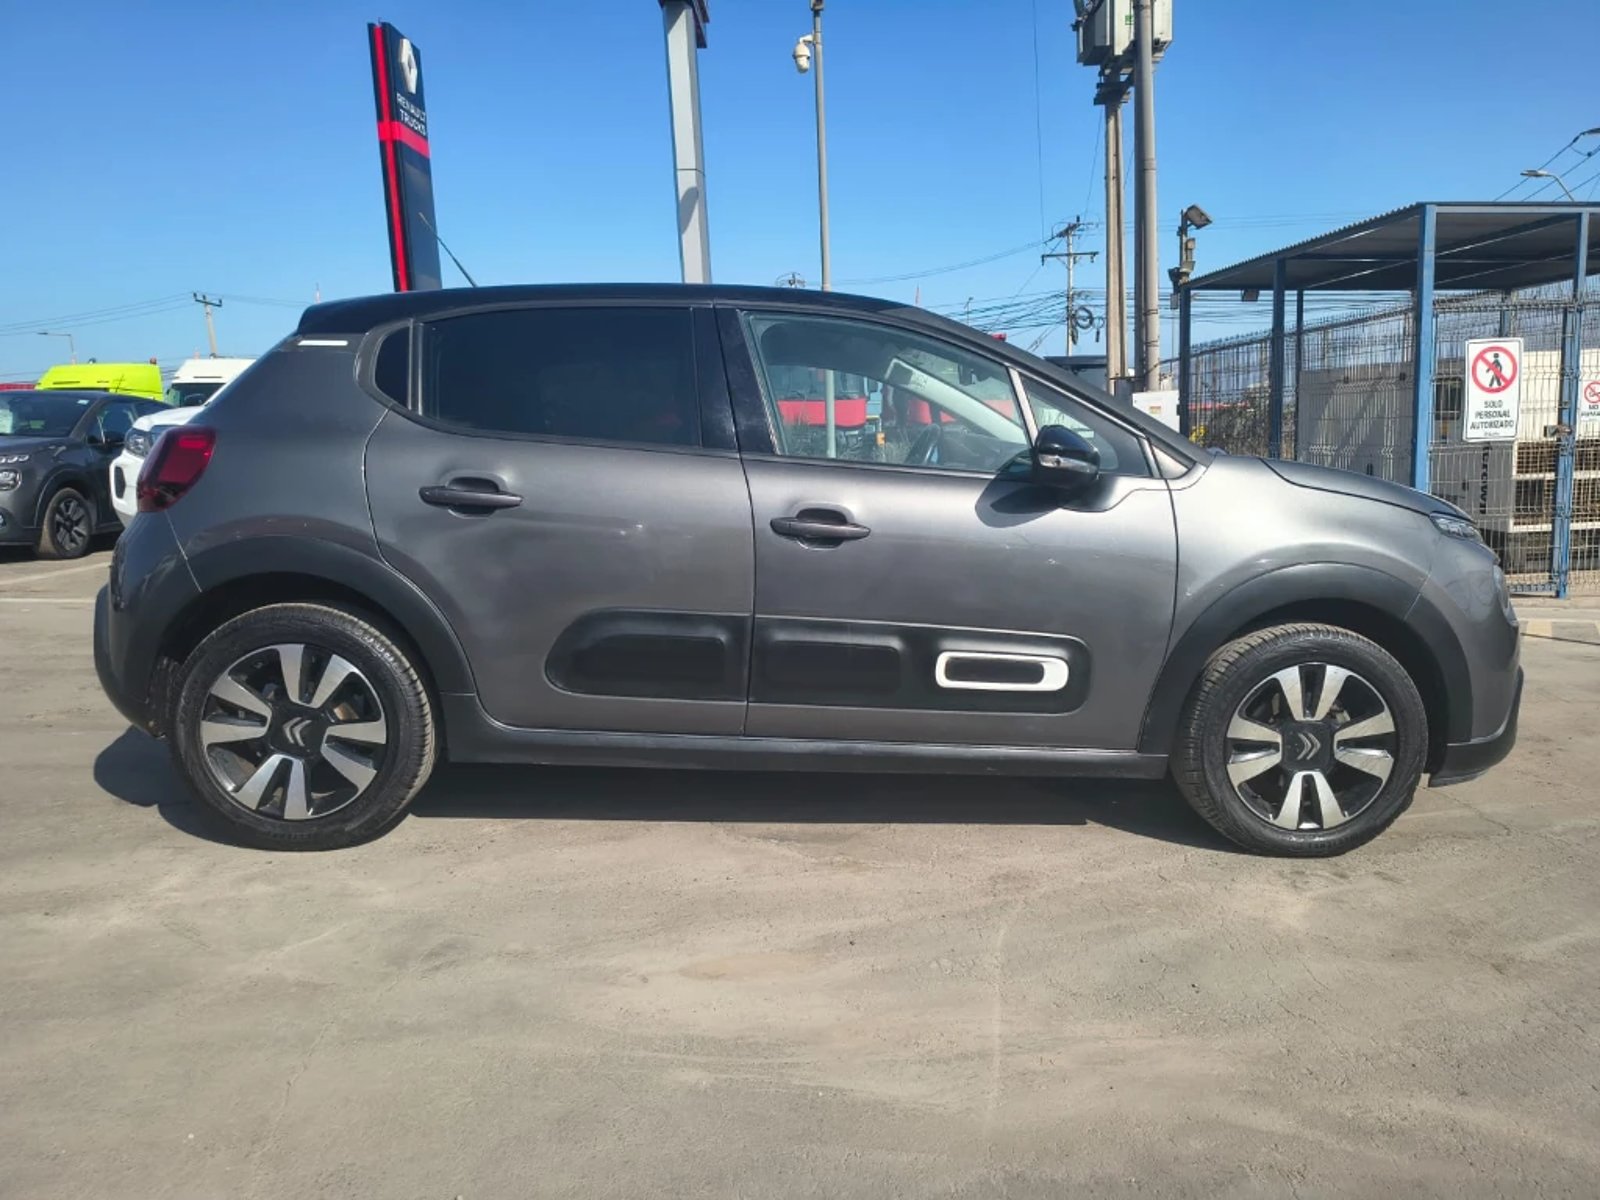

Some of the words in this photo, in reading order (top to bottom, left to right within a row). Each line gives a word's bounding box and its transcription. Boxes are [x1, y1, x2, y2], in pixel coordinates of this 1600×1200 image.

[1484, 400, 1503, 409] SOLO
[1475, 409, 1510, 419] PERSONAL
[1470, 420, 1514, 430] AUTORIZADO
